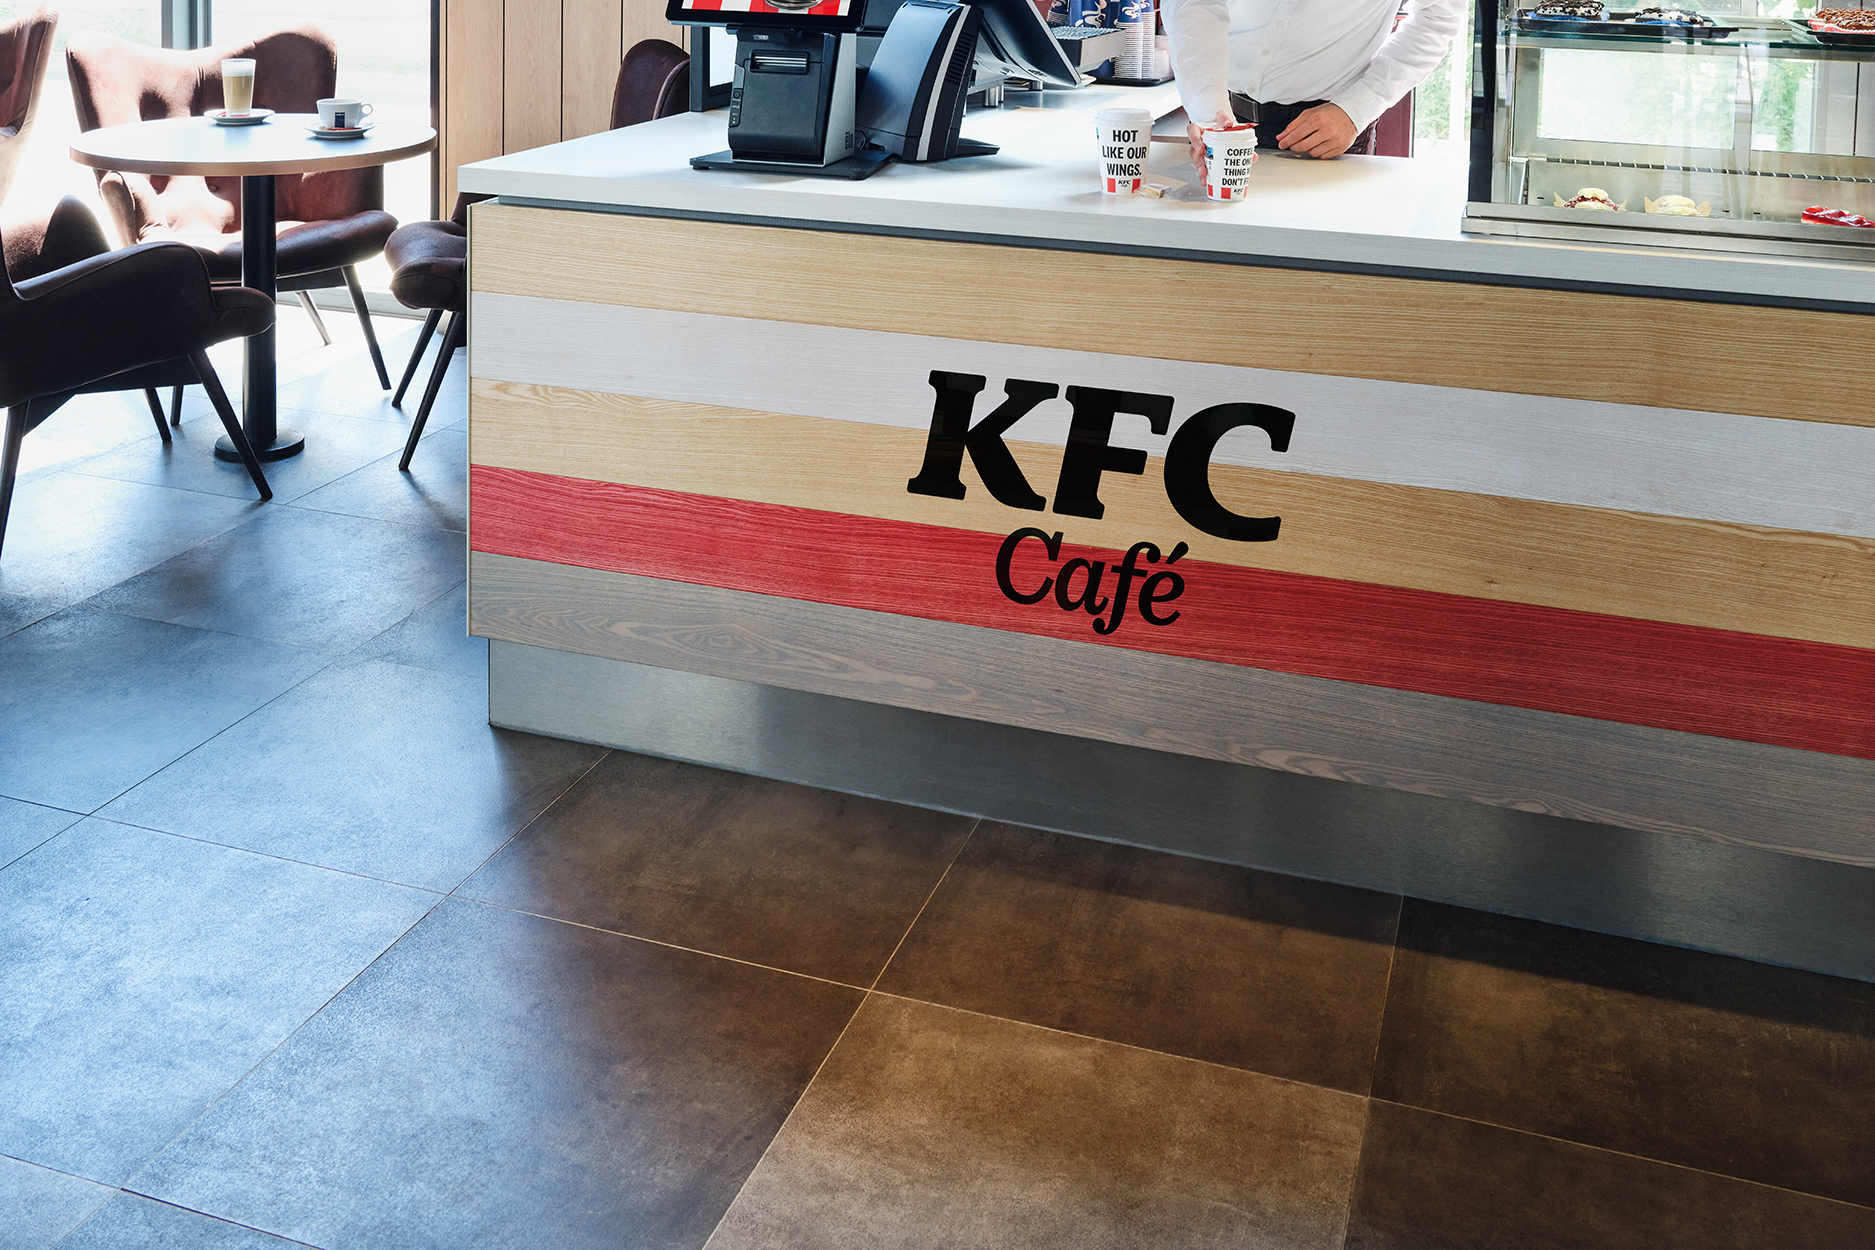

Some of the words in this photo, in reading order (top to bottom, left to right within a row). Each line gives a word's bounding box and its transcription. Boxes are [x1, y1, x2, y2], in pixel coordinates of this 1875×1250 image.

[1112, 129, 1139, 143] HOT
[1102, 145, 1124, 159] LIKE
[1127, 146, 1147, 159] OUR
[1106, 162, 1142, 176] WINGS.
[1224, 158, 1241, 166] THE
[1224, 168, 1246, 176] THING
[1222, 177, 1243, 186] DON'T
[906, 369, 1296, 542] KFC
[995, 526, 1190, 635] Café
